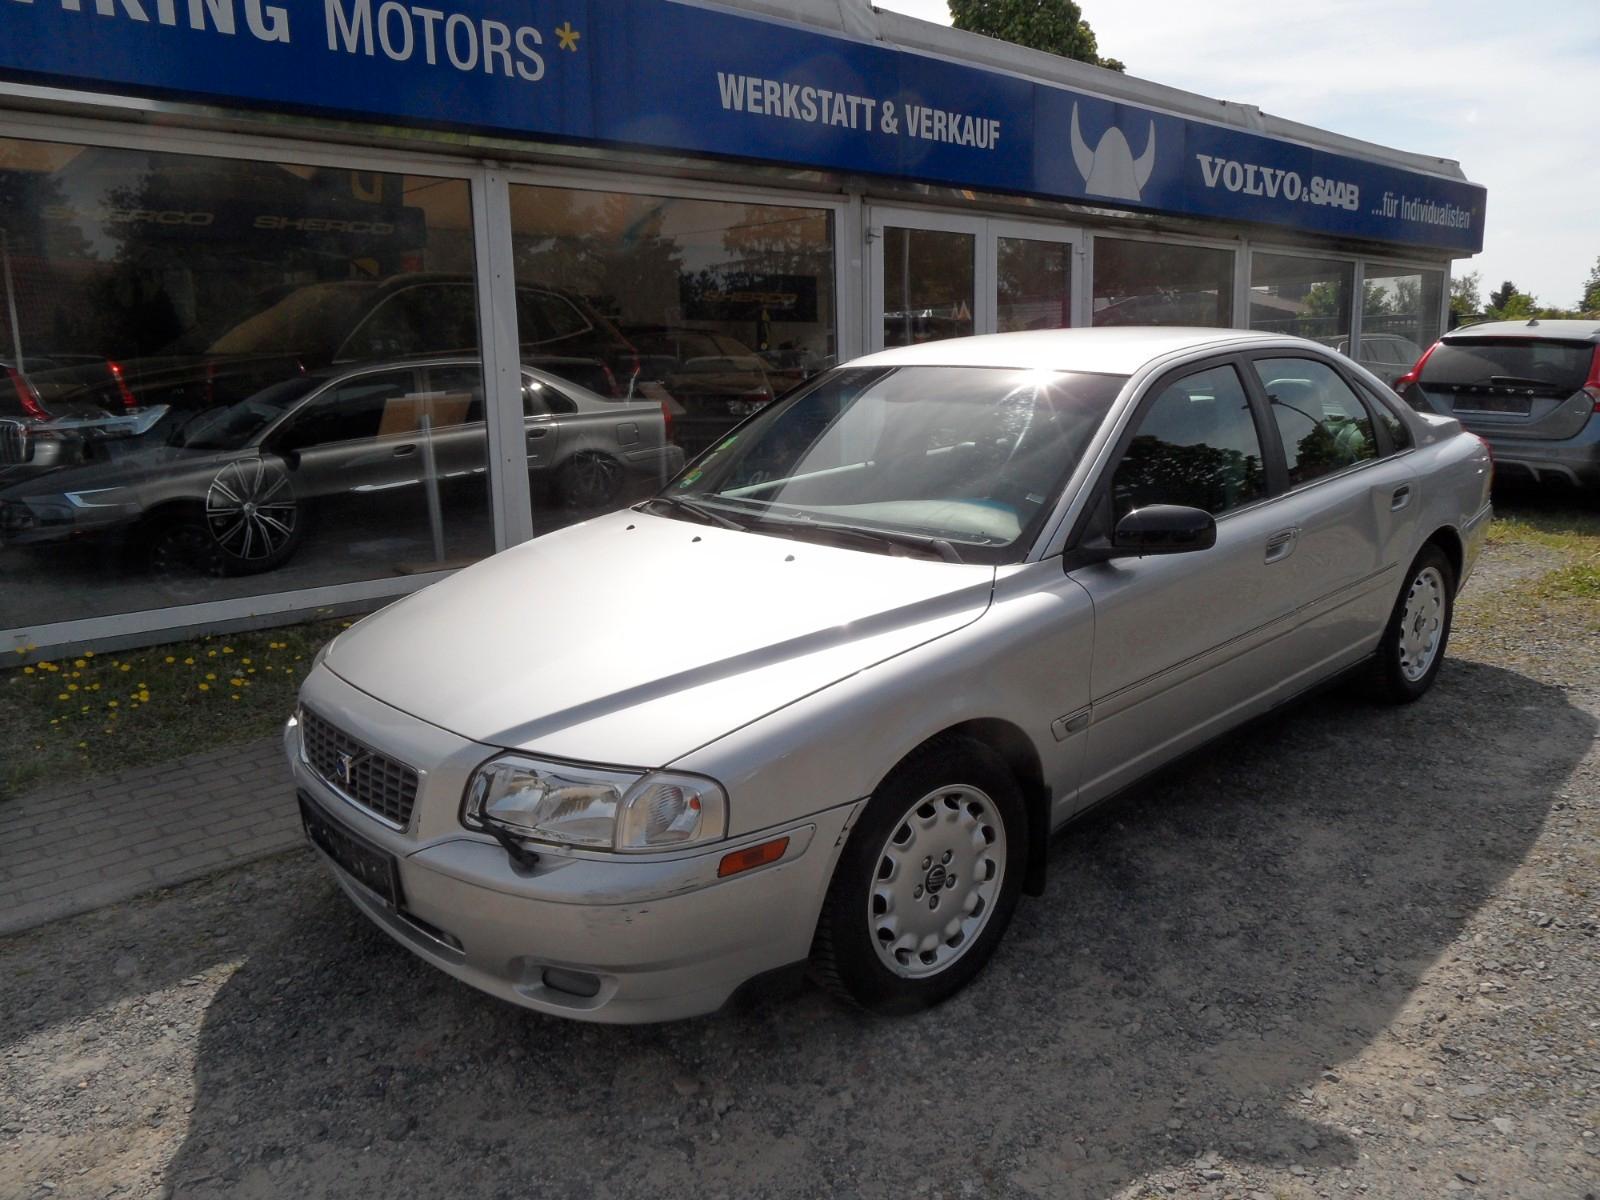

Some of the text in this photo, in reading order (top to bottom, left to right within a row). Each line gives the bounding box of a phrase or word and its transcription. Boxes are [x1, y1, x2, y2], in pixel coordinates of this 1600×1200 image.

[324, 0, 546, 81] MOTORS
[717, 72, 1000, 150] WERKSTATT & VERKAUF
[253, 215, 394, 233] SHERCO
[1401, 195, 1470, 229] Individualisten
